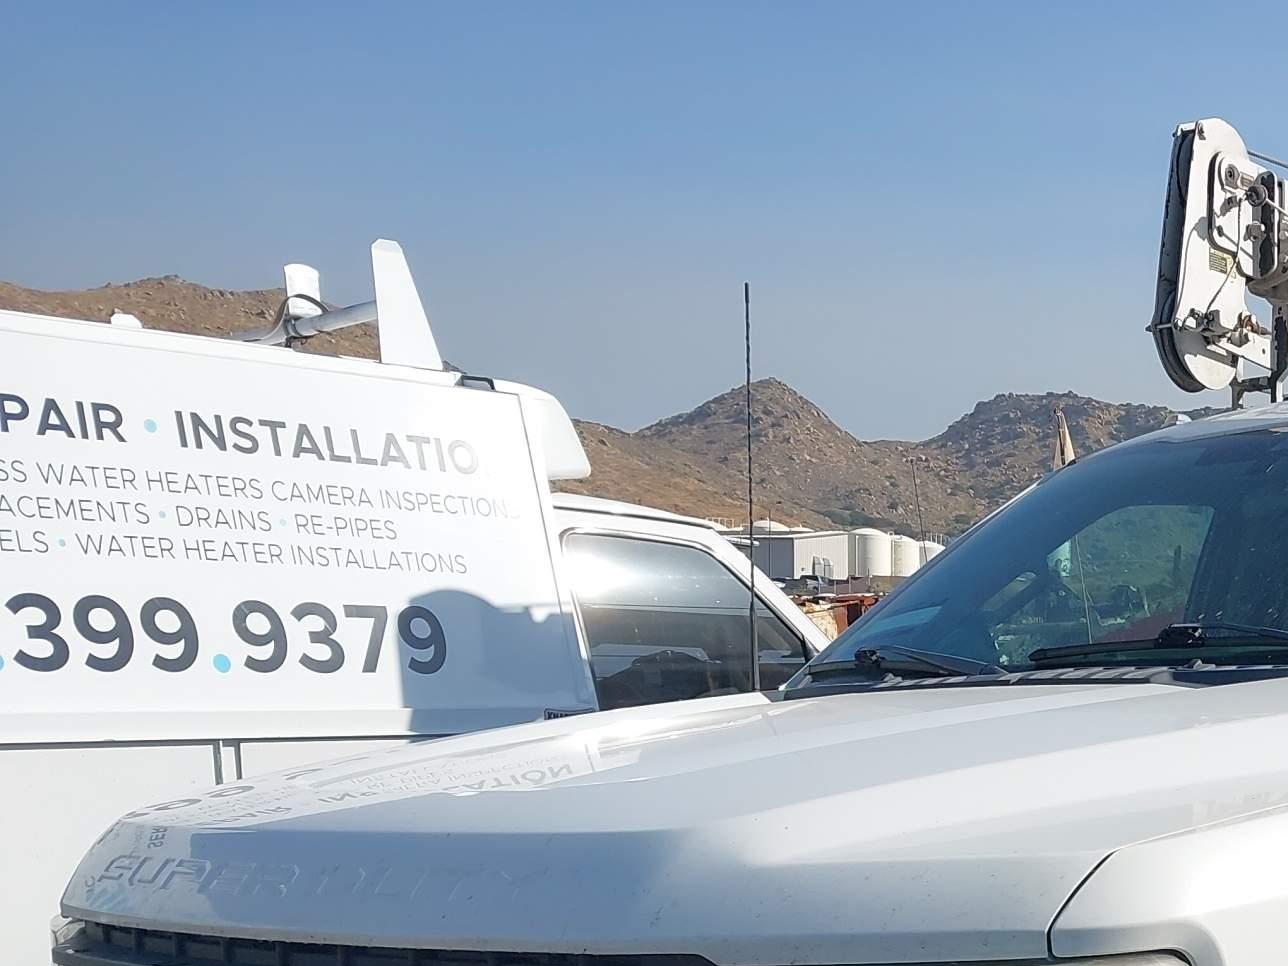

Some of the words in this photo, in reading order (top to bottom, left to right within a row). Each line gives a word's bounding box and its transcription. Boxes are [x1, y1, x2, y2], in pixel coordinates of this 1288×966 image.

[0, 393, 127, 443] PAIR
[174, 410, 490, 477] INSTALLATIO
[36, 461, 138, 491] WATER
[145, 470, 264, 500] HEATERS
[271, 480, 374, 508] CAMERA
[176, 505, 272, 532] DRAINS
[295, 513, 398, 540] RE-PIPES
[75, 533, 176, 560] WATER
[183, 538, 283, 565] HEATER
[290, 544, 468, 574] INSTALLATIONS
[0, 592, 447, 674] 399.9379
